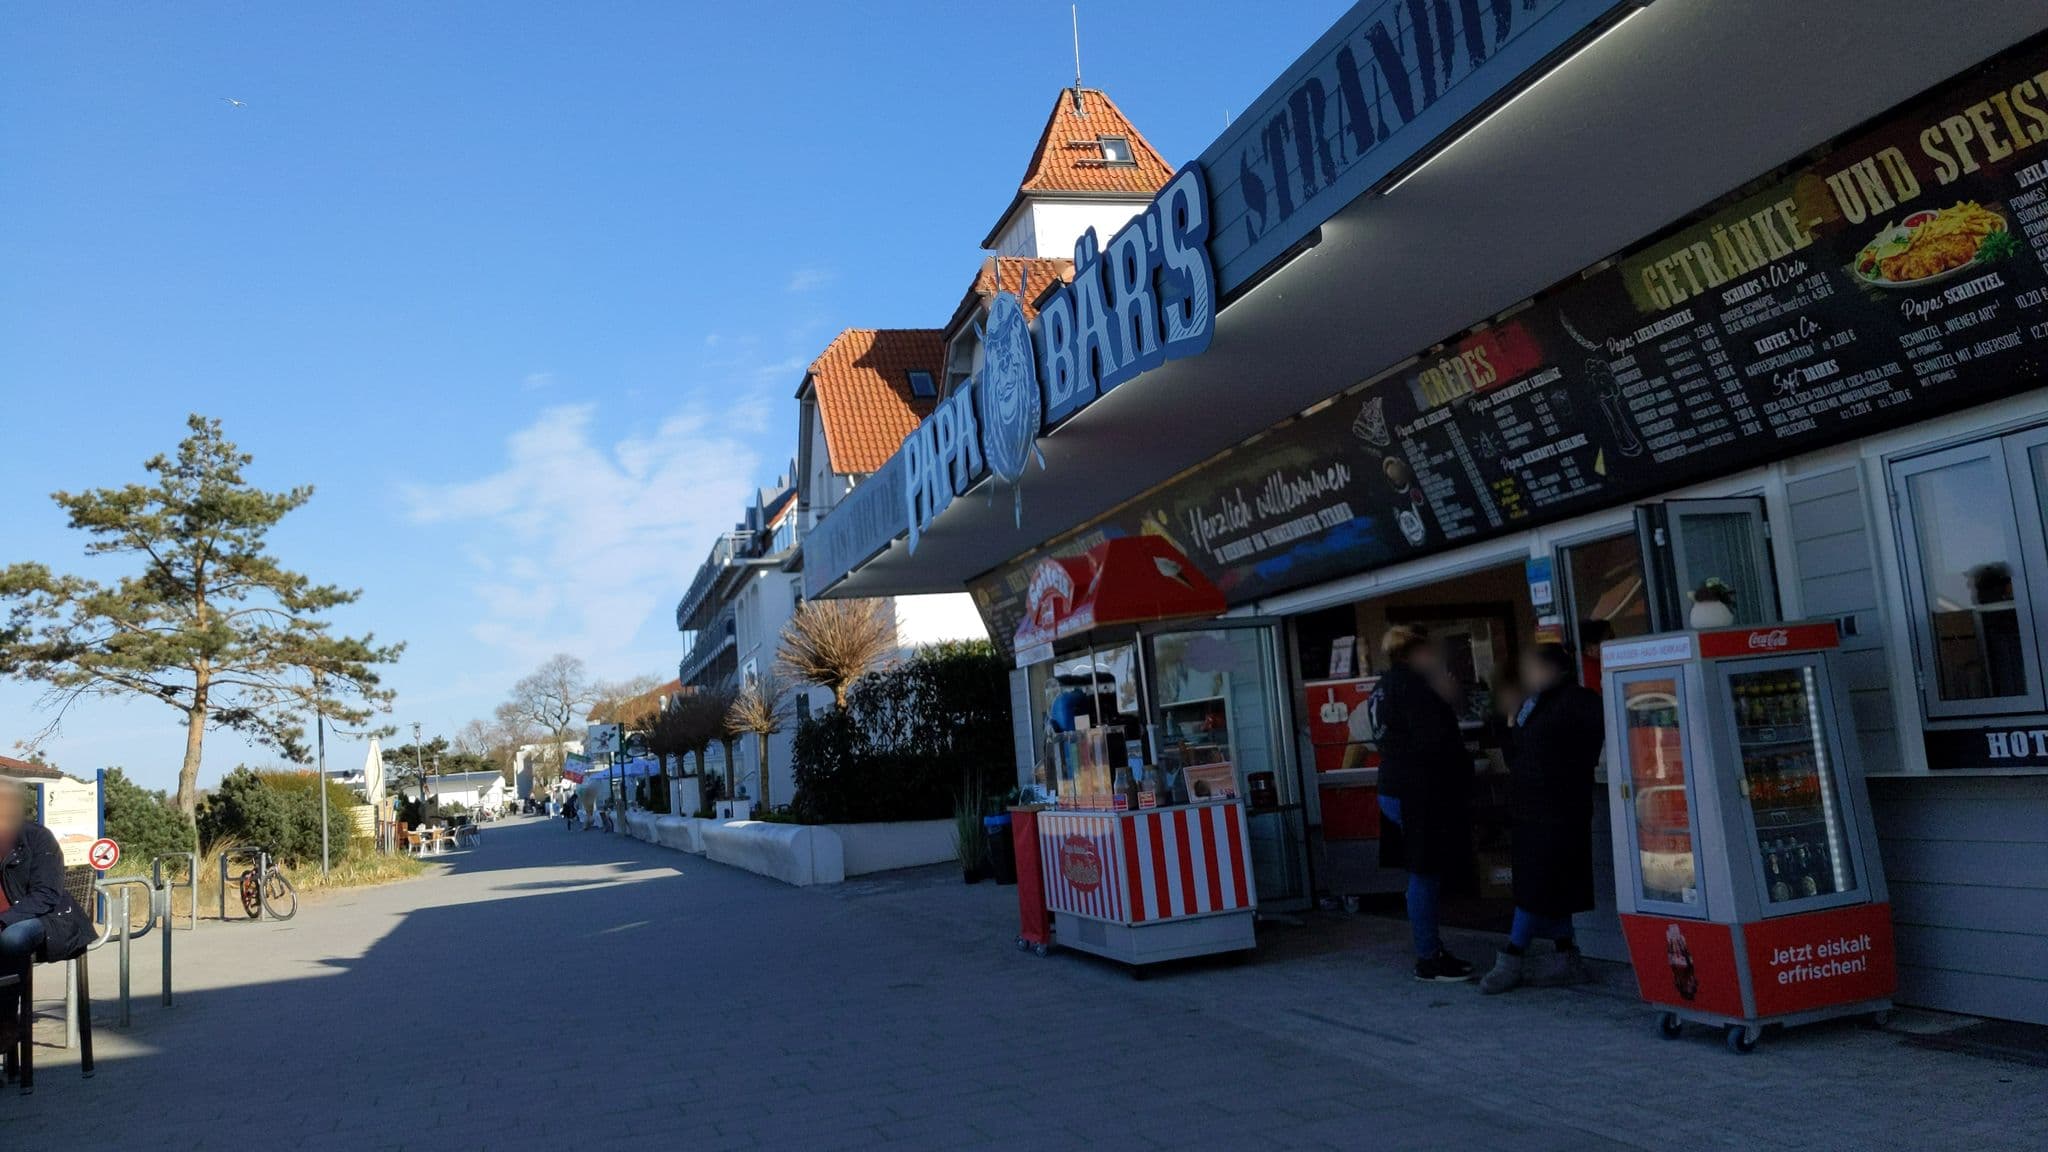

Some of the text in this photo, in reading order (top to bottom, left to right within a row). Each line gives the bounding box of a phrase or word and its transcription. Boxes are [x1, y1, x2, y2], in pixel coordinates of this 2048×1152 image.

[1825, 146, 1921, 225] UND
[1901, 272, 2005, 321] Papas SCHNITZEL
[1899, 325, 1943, 349] SCHNITZEL
[2014, 290, 2042, 310] 10.20
[1754, 331, 1791, 354] KAFFEE
[904, 381, 983, 556] PAPA
[1039, 166, 1212, 417] BÄR'S
[1912, 353, 1958, 377] SCHNITZEL
[1955, 346, 1972, 364] MIT
[1748, 630, 1788, 650] Coca-Cola
[1985, 730, 2048, 759] HOT
[1768, 934, 1872, 968] Jetzt eiskalt
[1777, 955, 1867, 986] erfrischen!
